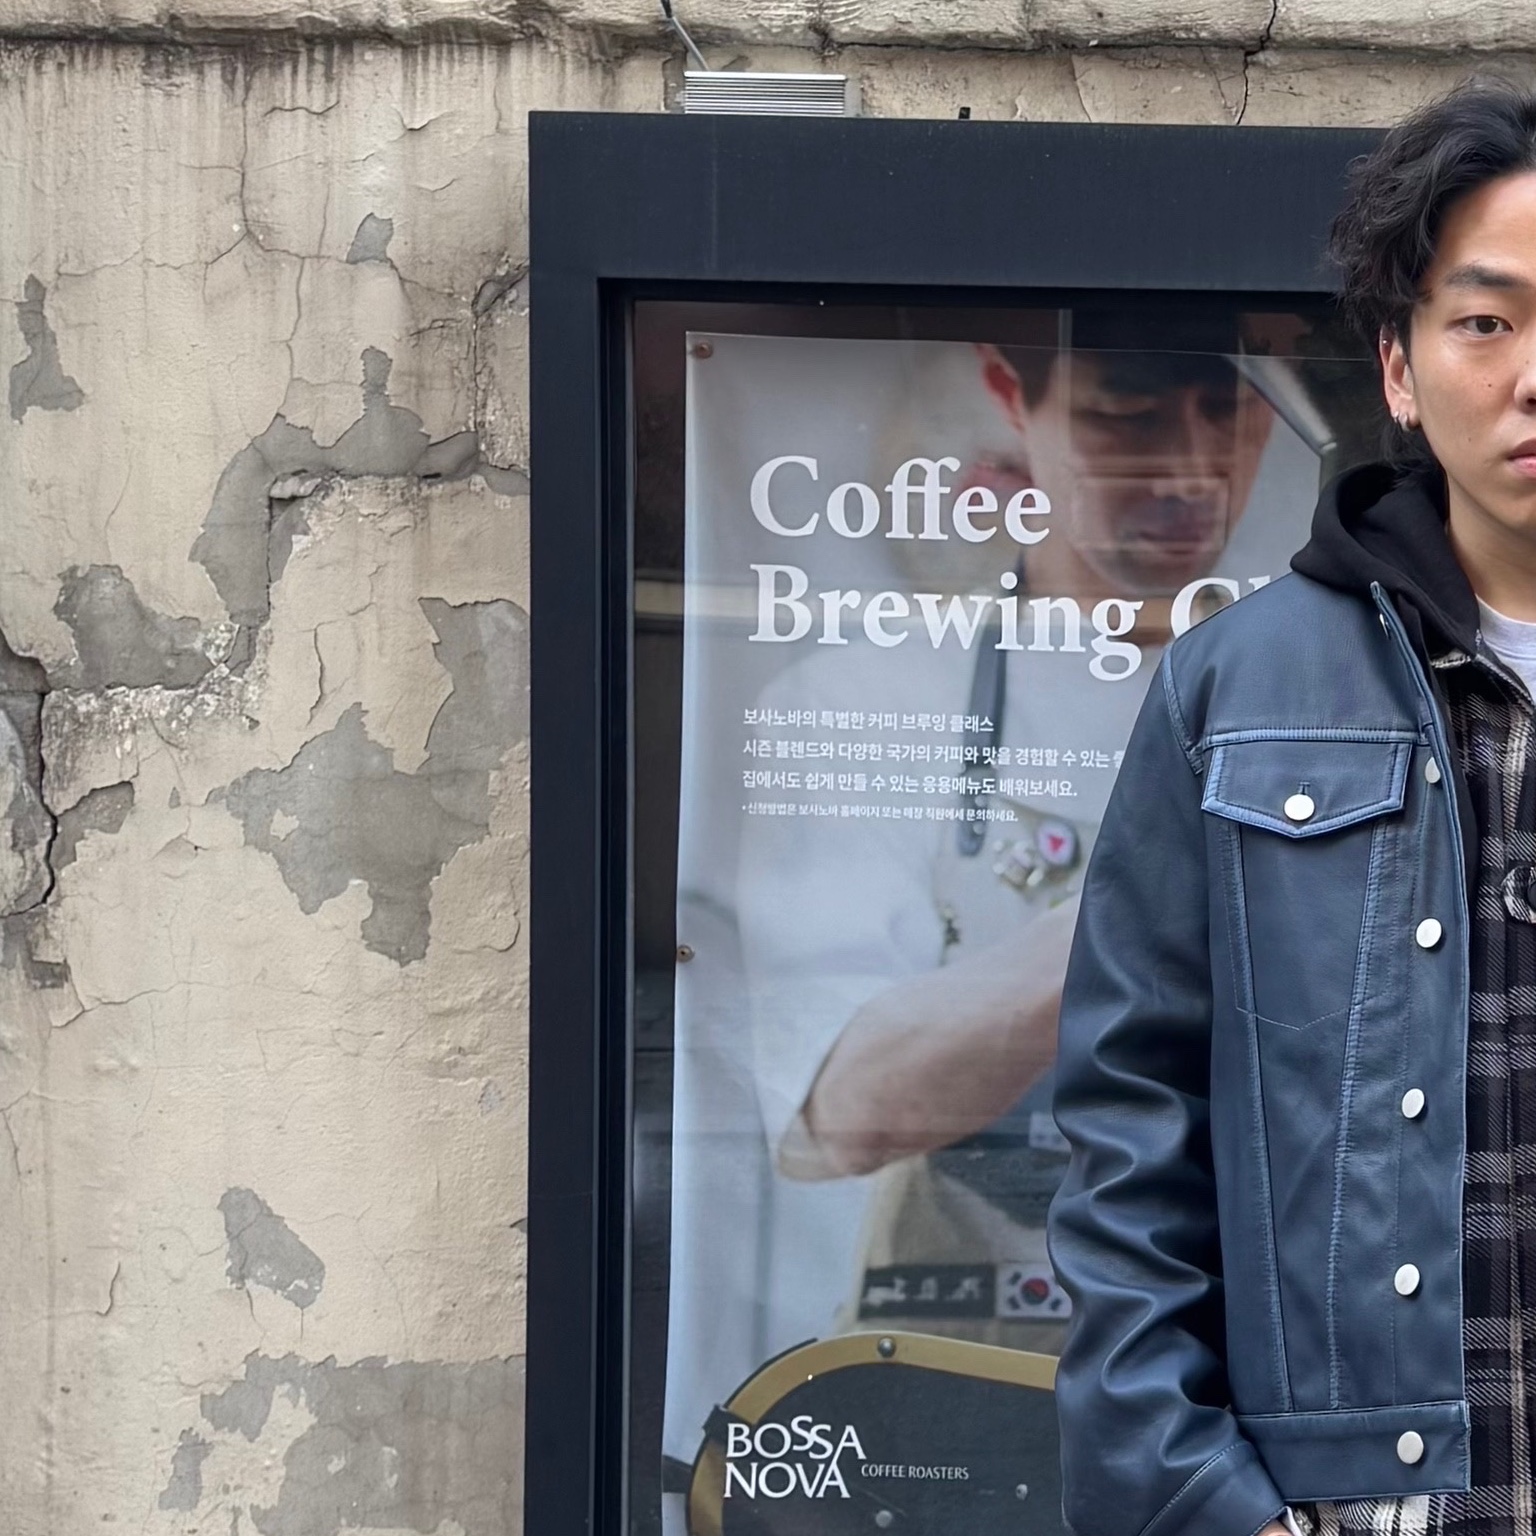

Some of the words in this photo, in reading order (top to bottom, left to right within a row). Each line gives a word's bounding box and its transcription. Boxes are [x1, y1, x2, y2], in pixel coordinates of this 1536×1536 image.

[749, 454, 1052, 545] Coffee
[747, 562, 1143, 682] Brewing
[1170, 575, 1272, 638] C
[743, 708, 817, 729] 보사노바의
[820, 710, 865, 730] 특별한
[867, 711, 898, 731] 커피
[901, 713, 946, 733] 브루잉
[949, 714, 995, 734] 클래스
[742, 739, 772, 759] 시즌
[775, 741, 834, 760] 블렌드와
[838, 742, 883, 761] 다양한
[886, 743, 931, 763] 국가의
[933, 745, 979, 765] 커피와
[982, 746, 1012, 767] 맛을
[1015, 748, 1060, 768] 경험할
[1062, 748, 1078, 767] 수
[1080, 749, 1111, 769] 있는
[742, 770, 802, 790] 집에서도
[804, 772, 834, 791] 쉽게
[837, 773, 867, 792] 만들
[870, 774, 887, 793] 수
[889, 775, 920, 794] 있는
[922, 775, 997, 796] 응용메뉴도
[999, 777, 1078, 798] 배워보세요.
[726, 1415, 867, 1462] BOSSA
[723, 1457, 851, 1499] NOVA
[860, 1463, 906, 1479] COFFEE
[907, 1466, 970, 1480] ROASTERS
